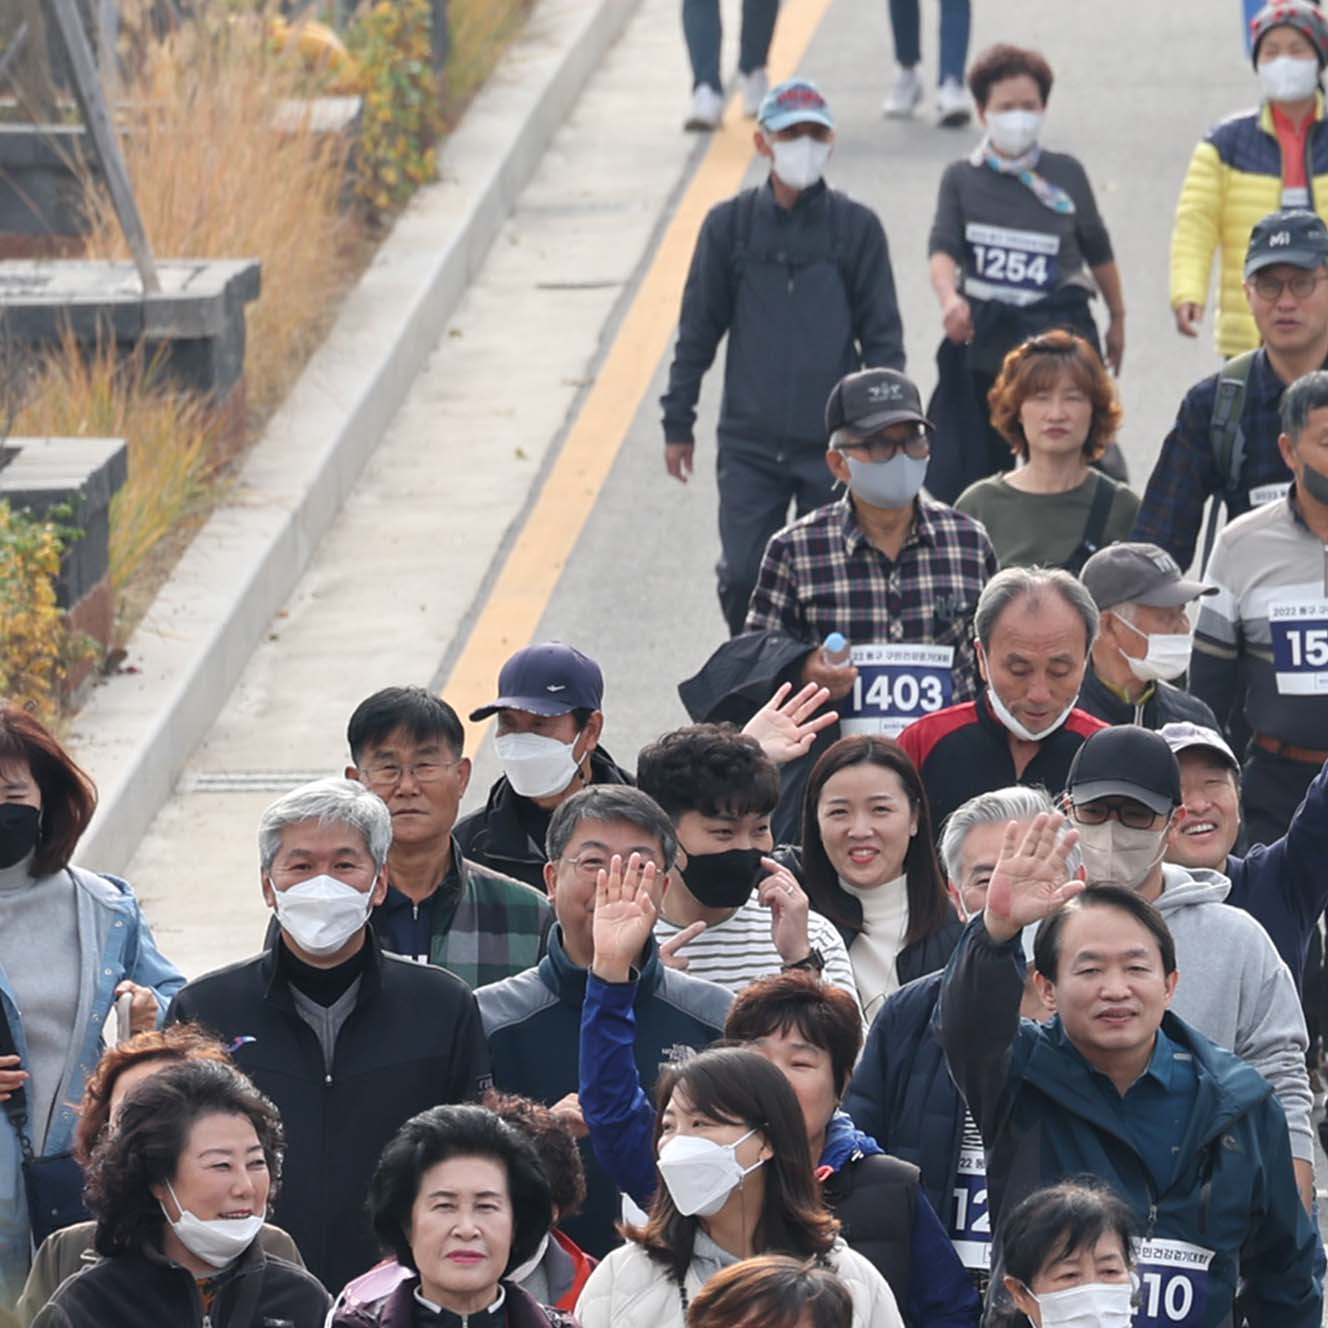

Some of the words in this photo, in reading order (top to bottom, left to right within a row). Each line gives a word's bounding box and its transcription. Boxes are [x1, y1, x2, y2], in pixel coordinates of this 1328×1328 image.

[973, 246, 1048, 285] 1254
[1274, 607, 1296, 617] 2022
[853, 674, 943, 712] 1403
[959, 1157, 972, 1169] 22
